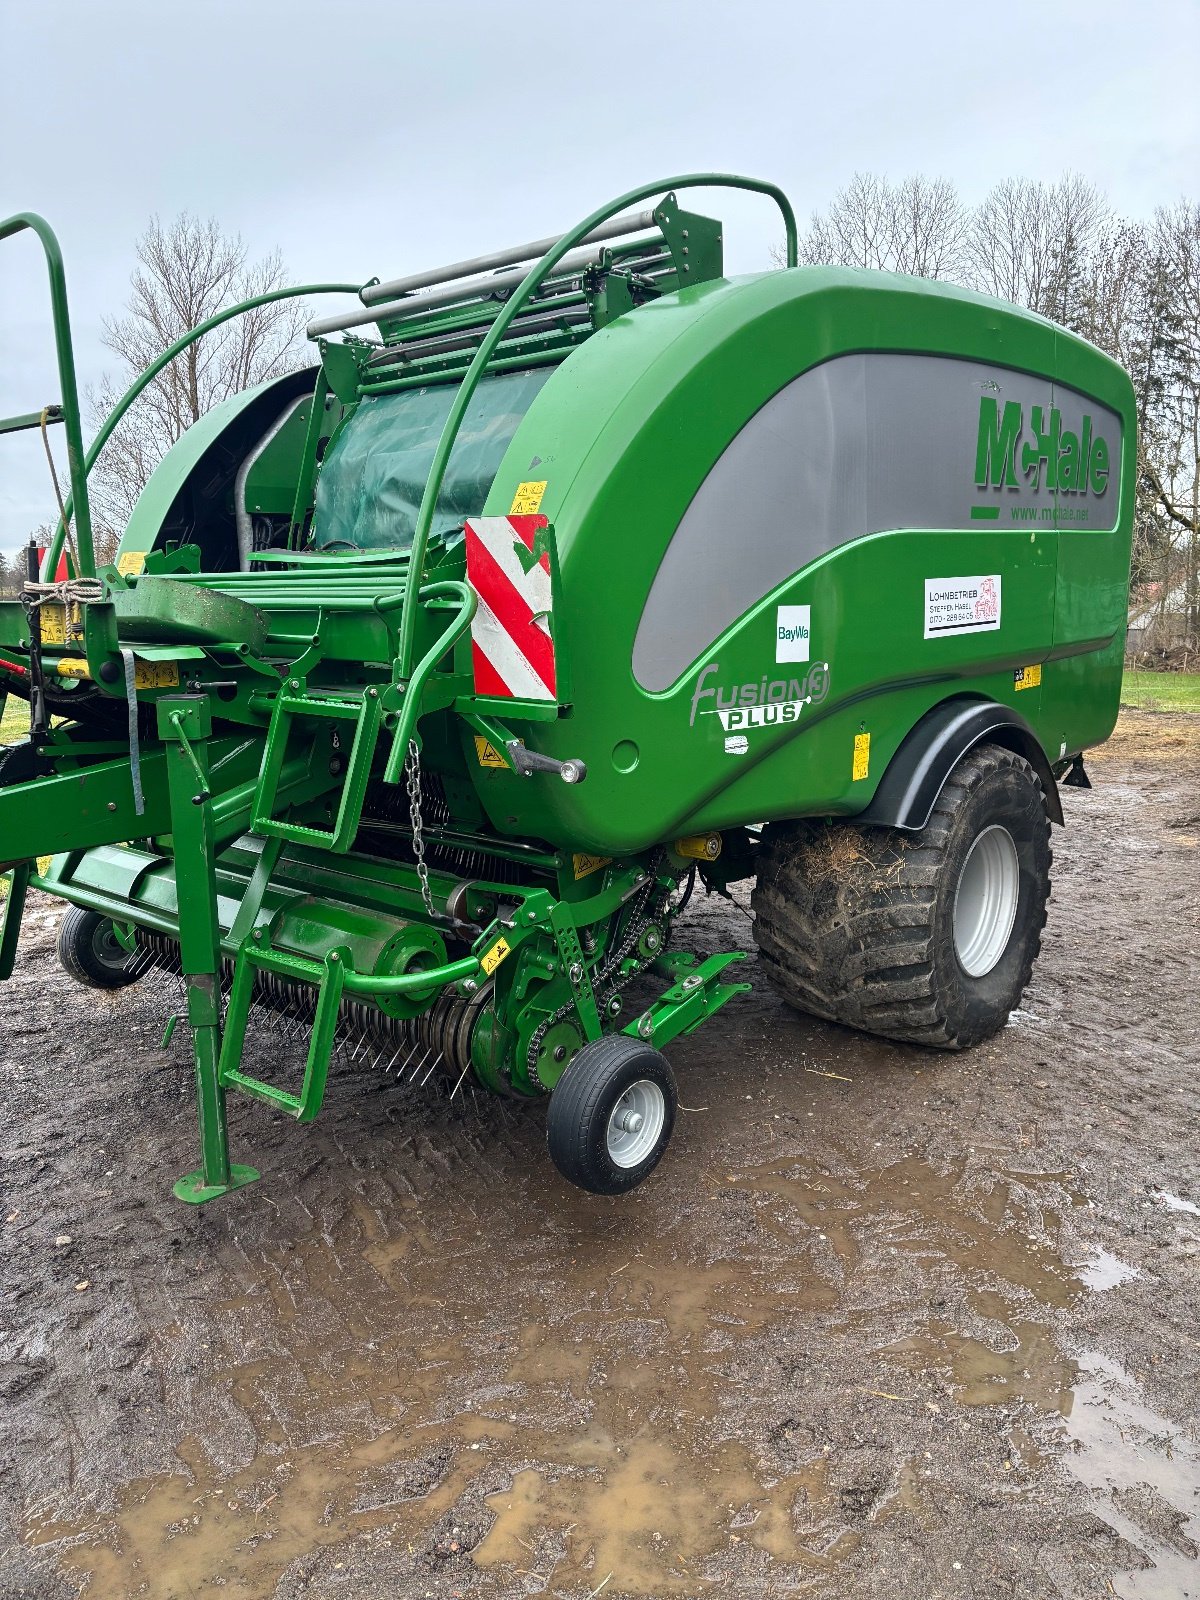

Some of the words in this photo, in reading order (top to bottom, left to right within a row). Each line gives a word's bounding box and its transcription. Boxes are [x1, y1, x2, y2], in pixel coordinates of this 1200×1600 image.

[974, 396, 1110, 494] McHale
[1011, 504, 1089, 522] www.mchale.net
[929, 590, 977, 601] LOHNBETRIEB
[778, 625, 809, 642] BayWa
[727, 703, 796, 730] PLUS
